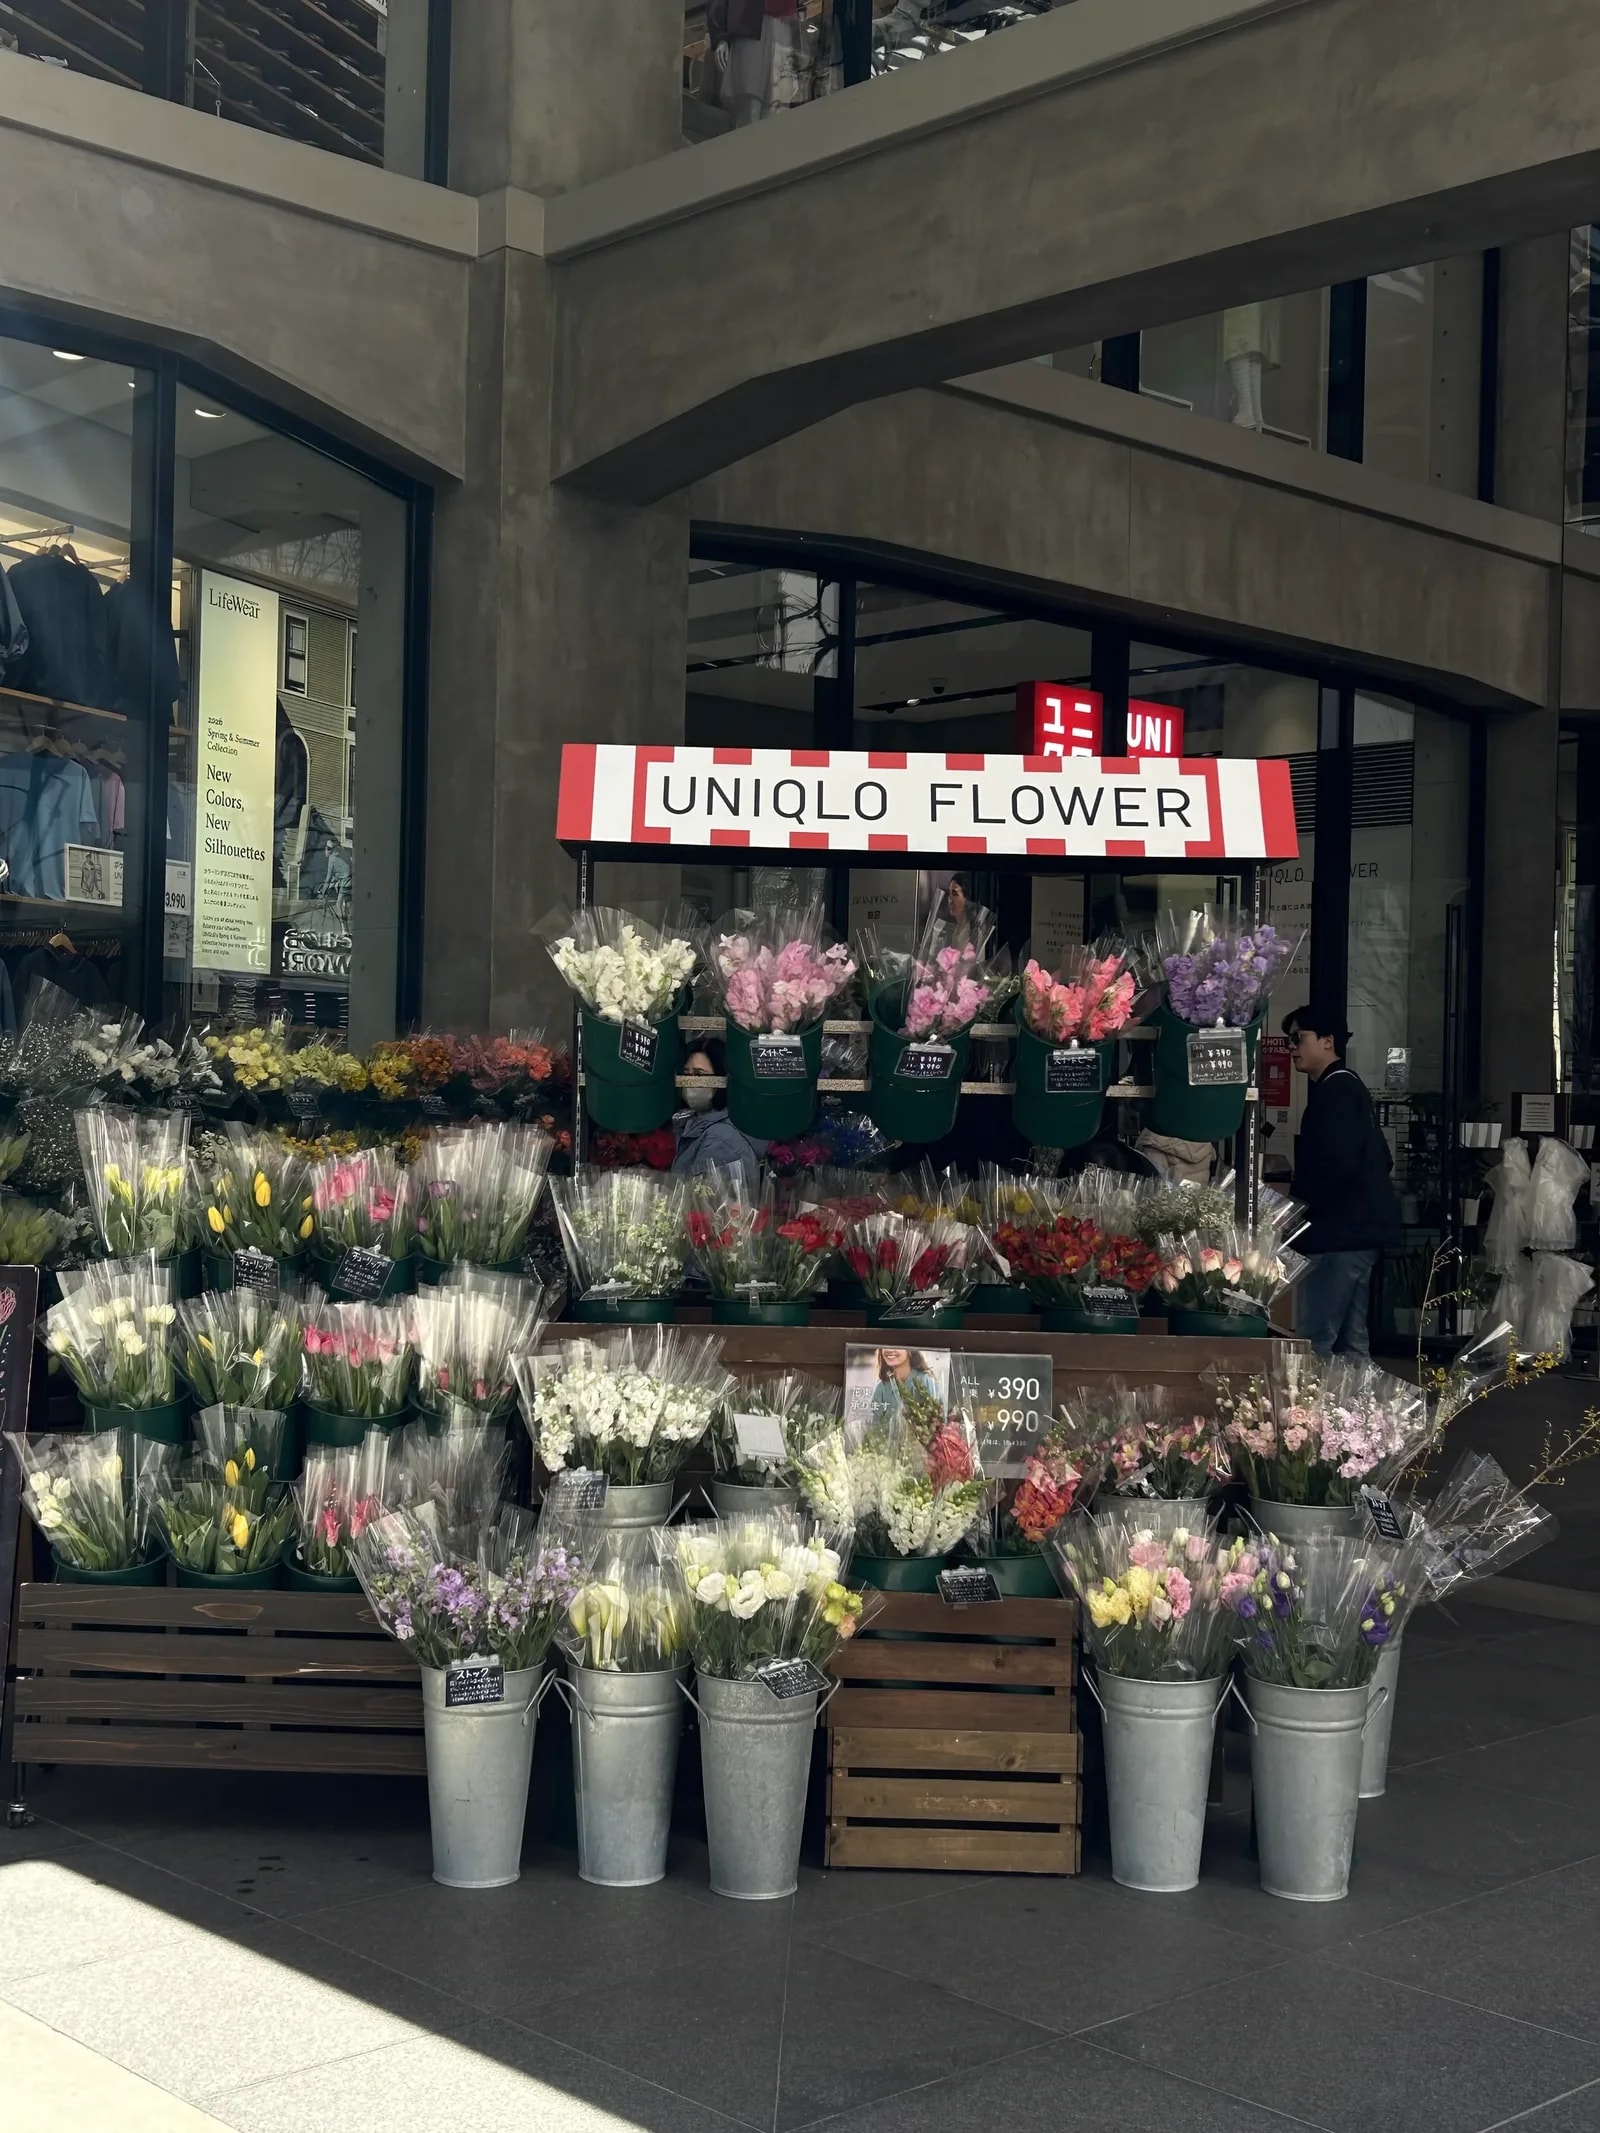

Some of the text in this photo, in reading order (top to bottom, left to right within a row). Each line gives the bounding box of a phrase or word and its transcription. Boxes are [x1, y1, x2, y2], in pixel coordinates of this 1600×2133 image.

[209, 588, 260, 619] LifeWear
[207, 728, 260, 748] Spring & Summer
[1127, 712, 1172, 754] UNI
[207, 740, 238, 756] Collection
[206, 763, 232, 783] New
[206, 788, 245, 812] Colors,
[662, 775, 1192, 828] UNIQLO FLOWER
[205, 812, 231, 831] New
[204, 837, 266, 862] Silhouettes
[1207, 1048, 1232, 1058] ¥390
[1209, 1060, 1233, 1071] ¥990
[960, 1375, 980, 1386] ALL
[988, 1376, 1040, 1401] ¥390
[988, 1408, 1039, 1433] ¥990
[456, 1667, 489, 1680] ストック
